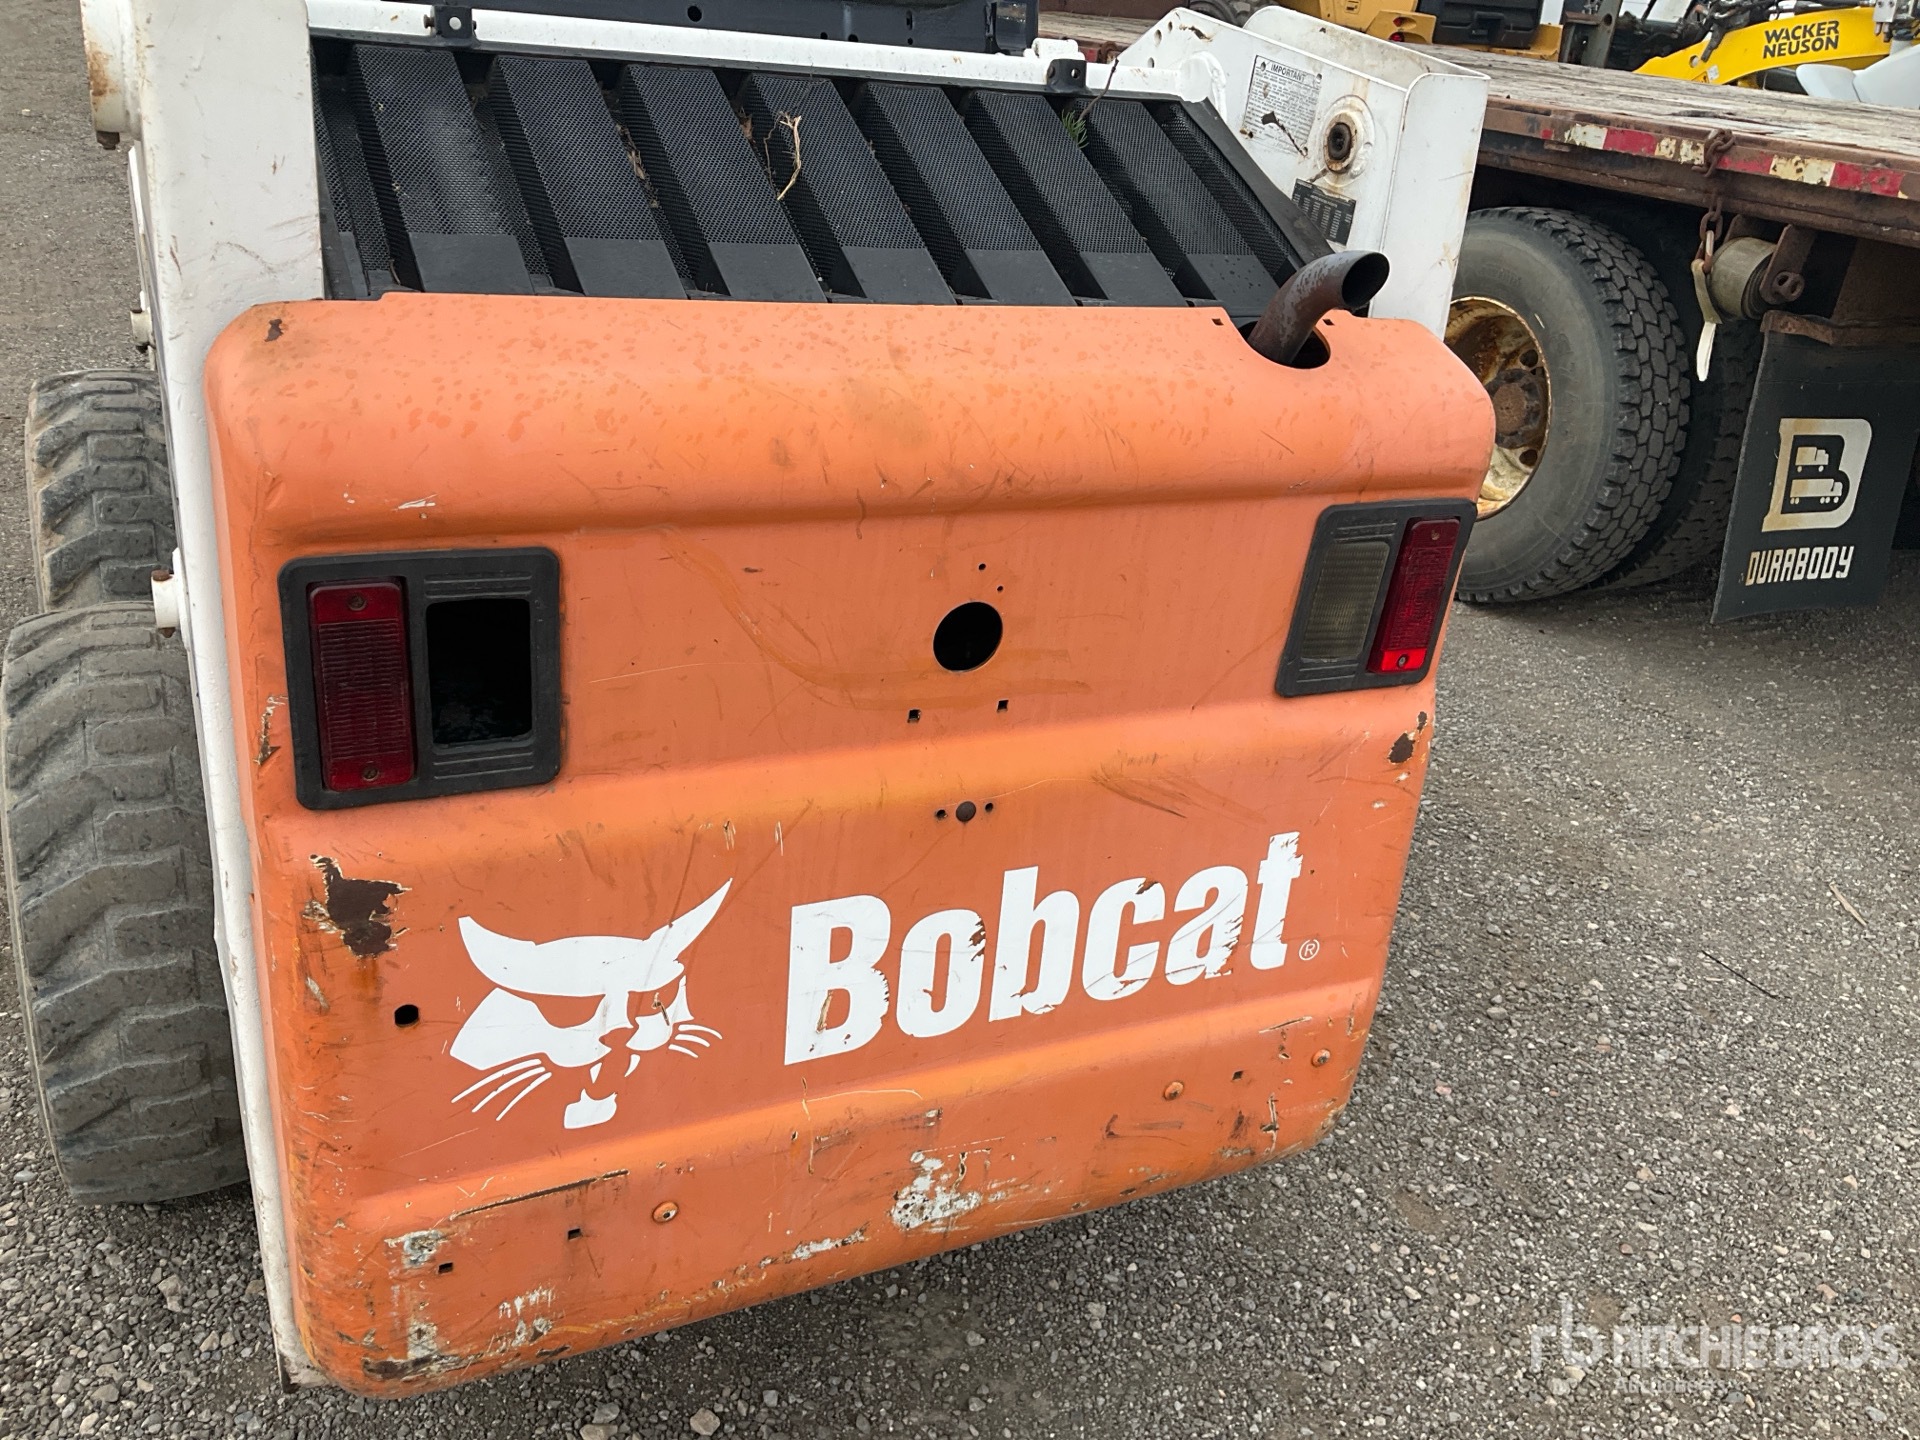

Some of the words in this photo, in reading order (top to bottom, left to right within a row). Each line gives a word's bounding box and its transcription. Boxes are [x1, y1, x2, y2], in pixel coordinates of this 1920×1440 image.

[1764, 20, 1840, 44] WACKER
[1762, 35, 1840, 59] NEUSON
[1270, 63, 1306, 82] IMPORTANT
[1745, 545, 1855, 586] DURABODY
[784, 831, 1304, 1066] Bobcat
